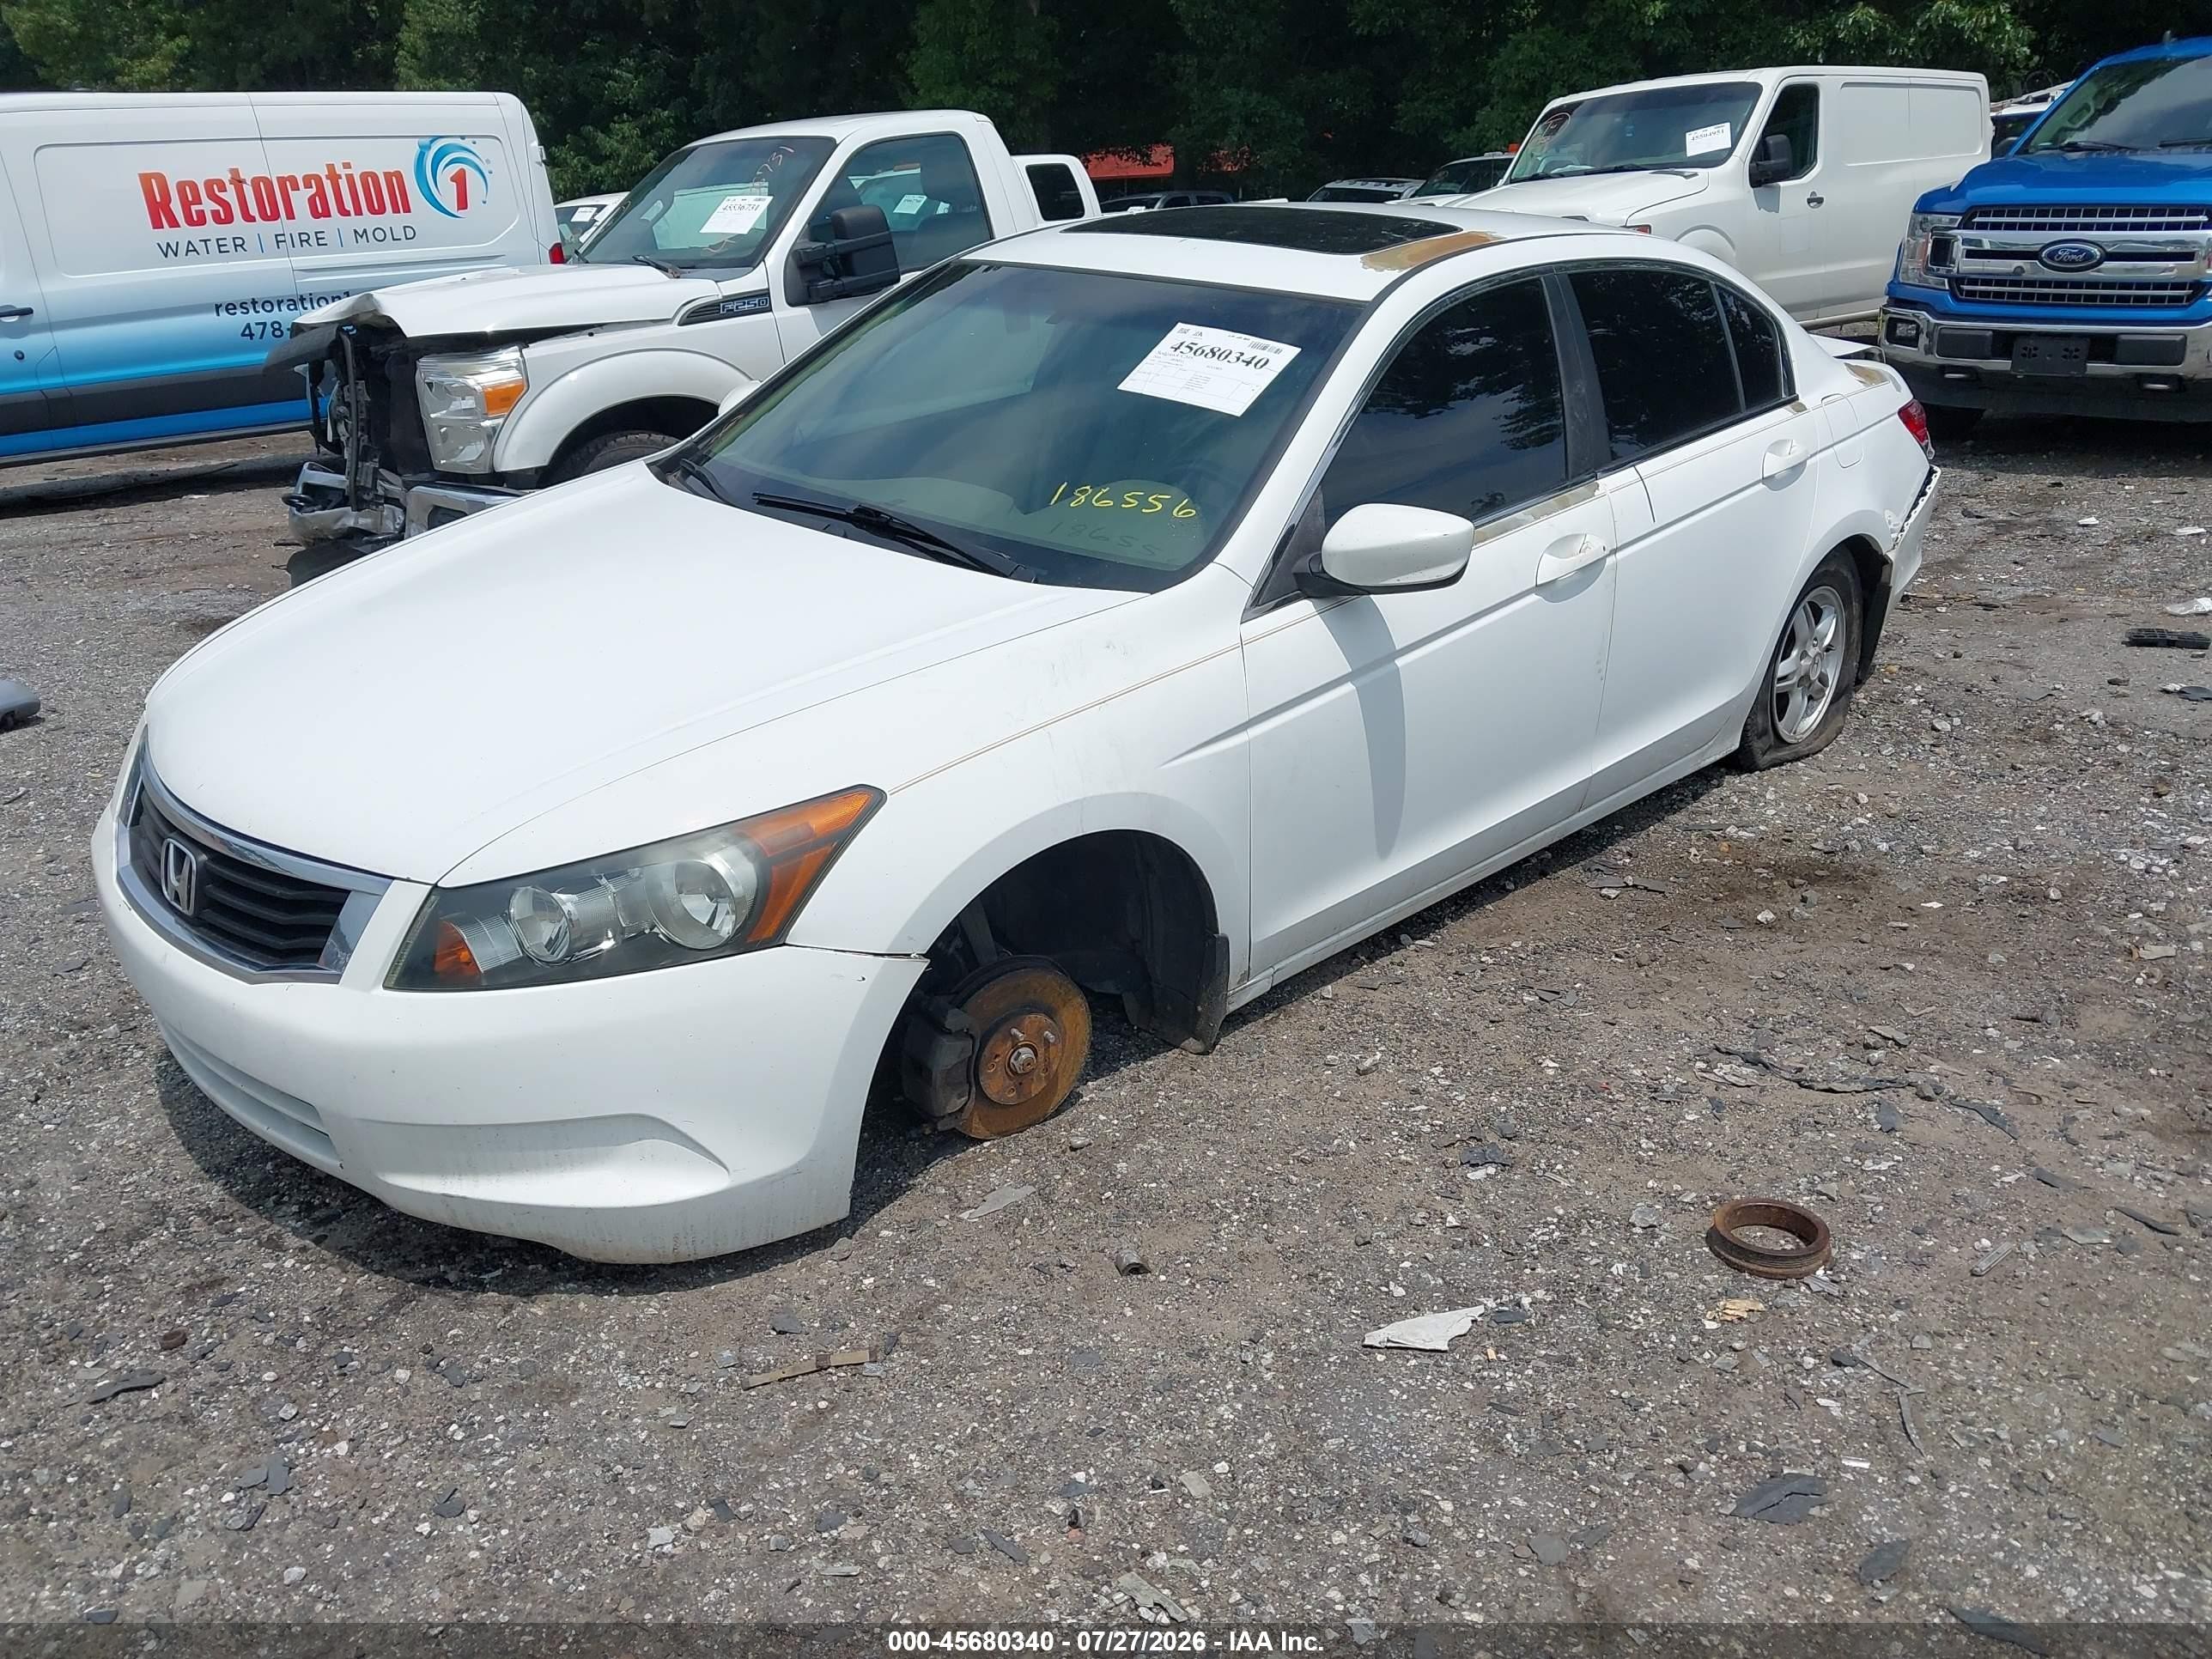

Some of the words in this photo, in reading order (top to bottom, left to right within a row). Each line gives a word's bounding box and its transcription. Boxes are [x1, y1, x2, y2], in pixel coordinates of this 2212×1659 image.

[137, 161, 412, 229] Restoration
[449, 167, 468, 212] 1
[156, 235, 247, 258] WATER
[273, 229, 328, 249] FIRE
[352, 224, 417, 244] MOLD
[2053, 248, 2087, 262] Ford
[720, 296, 769, 314] F-250
[1170, 340, 1270, 370] 45680340
[1049, 481, 1196, 519] 186556
